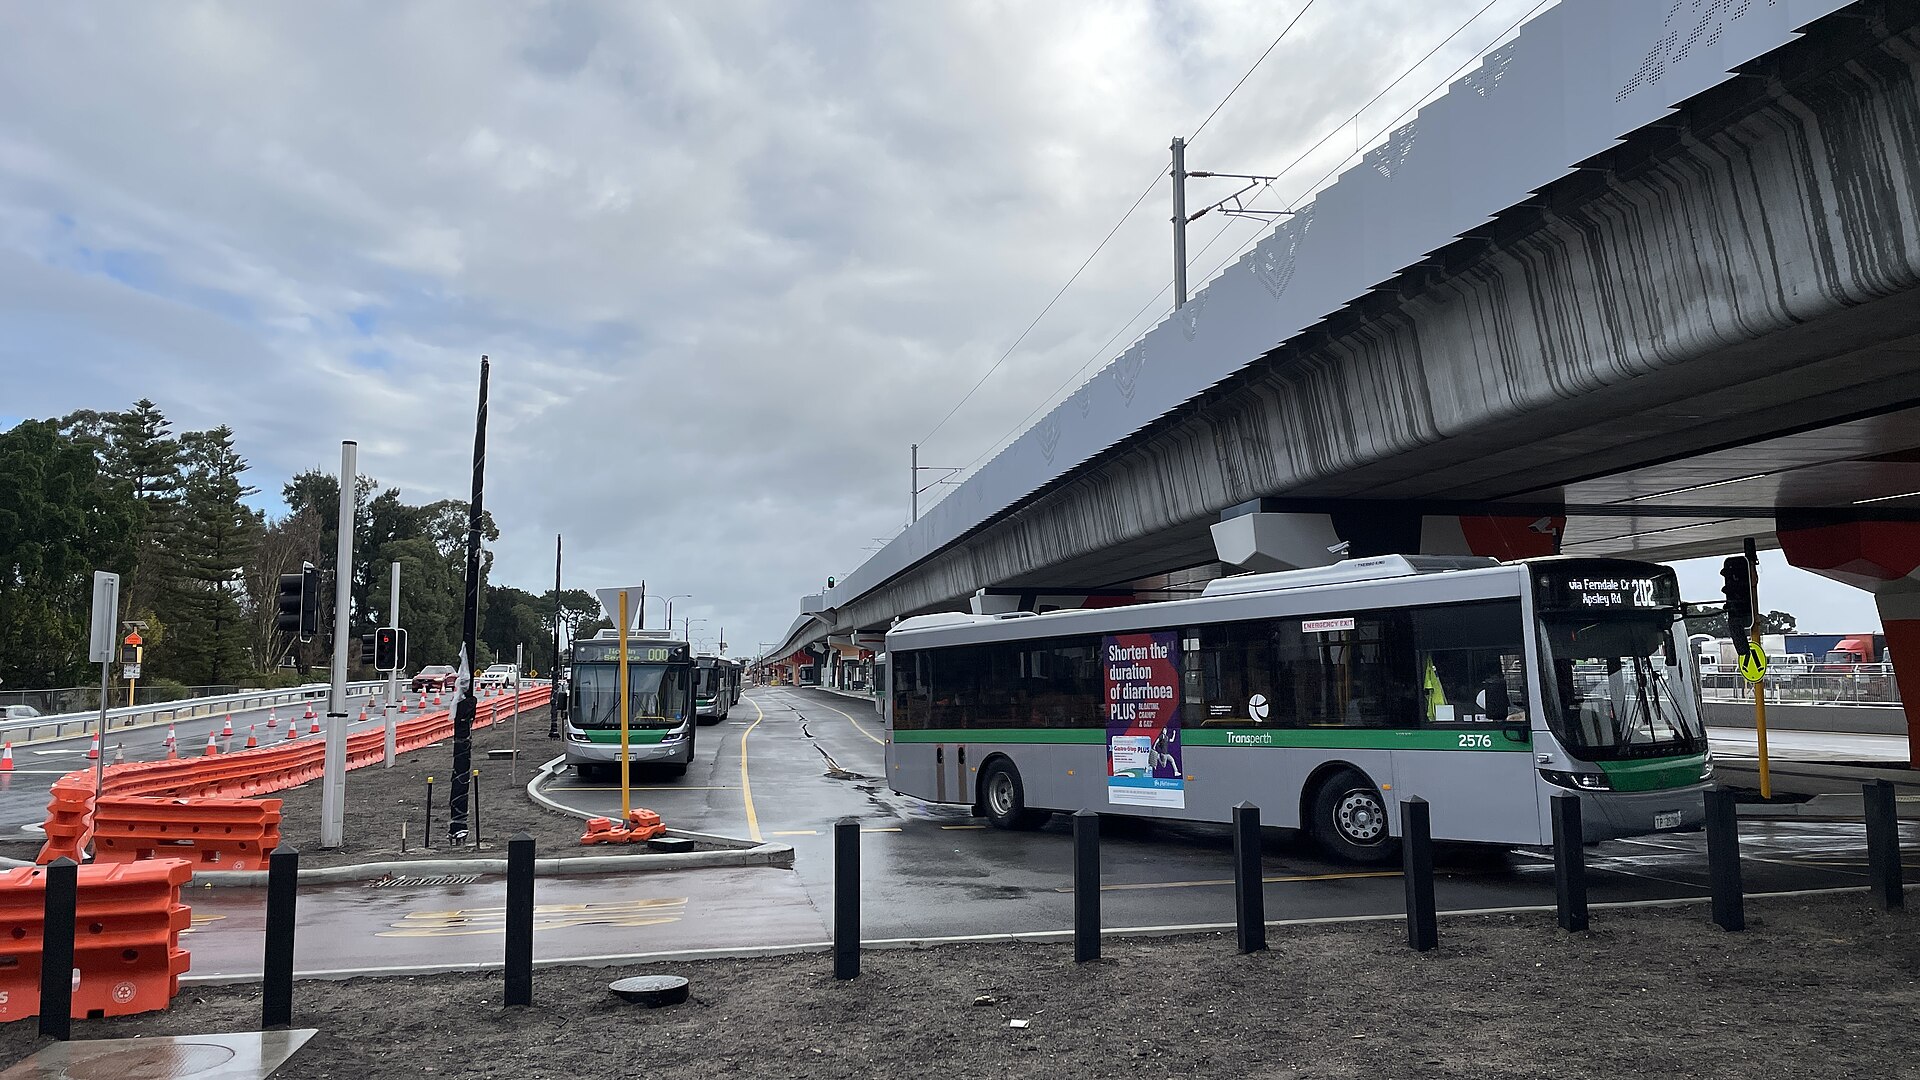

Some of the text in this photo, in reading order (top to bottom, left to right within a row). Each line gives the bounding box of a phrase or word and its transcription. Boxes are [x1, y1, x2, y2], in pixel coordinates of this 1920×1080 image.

[1568, 578, 1630, 590] via Ferndale Cr
[1582, 592, 1622, 607] Apsley Rd
[1631, 579, 1656, 607] 202
[1303, 619, 1354, 630] EMERGENCY EXIT
[647, 648, 669, 661] 000
[1108, 642, 1168, 662] Shorten the
[1109, 663, 1152, 680] duration
[1110, 682, 1173, 700] of diarrhoea
[1110, 702, 1136, 720] PLUS
[1226, 731, 1272, 746] Transperth
[1458, 734, 1492, 748] 2576
